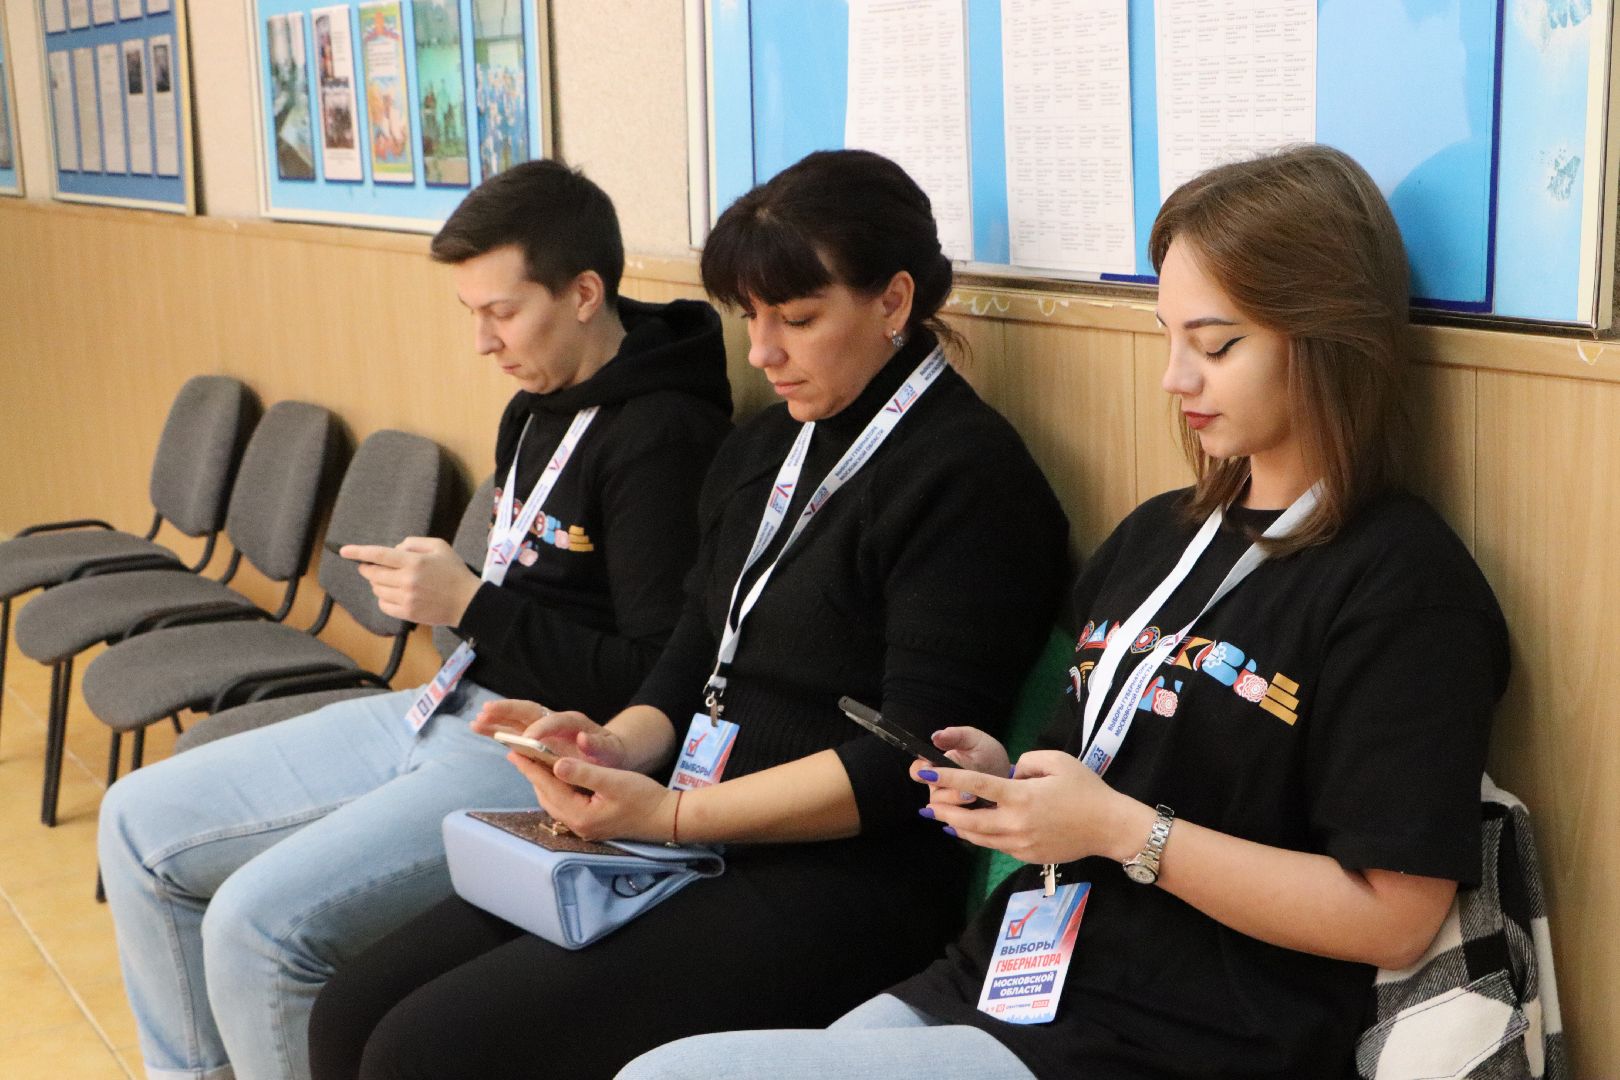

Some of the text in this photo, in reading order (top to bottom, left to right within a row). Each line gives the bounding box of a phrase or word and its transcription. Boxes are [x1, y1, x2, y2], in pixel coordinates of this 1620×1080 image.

[1107, 663, 1150, 731] ВЫБОРЫ ГУБЕРНАТОРА
[1114, 664, 1154, 736] МОСКОВСКОЙ ОБЛАСТИ
[681, 761, 712, 776] ВЫБОРЫ
[1001, 940, 1055, 956] ВЫБОРЫ
[996, 954, 1061, 972] ГУБЕРНАТОРА
[993, 971, 1054, 988] МОСКОВСКОЙ
[1001, 985, 1042, 996] ОБЛАСТИ
